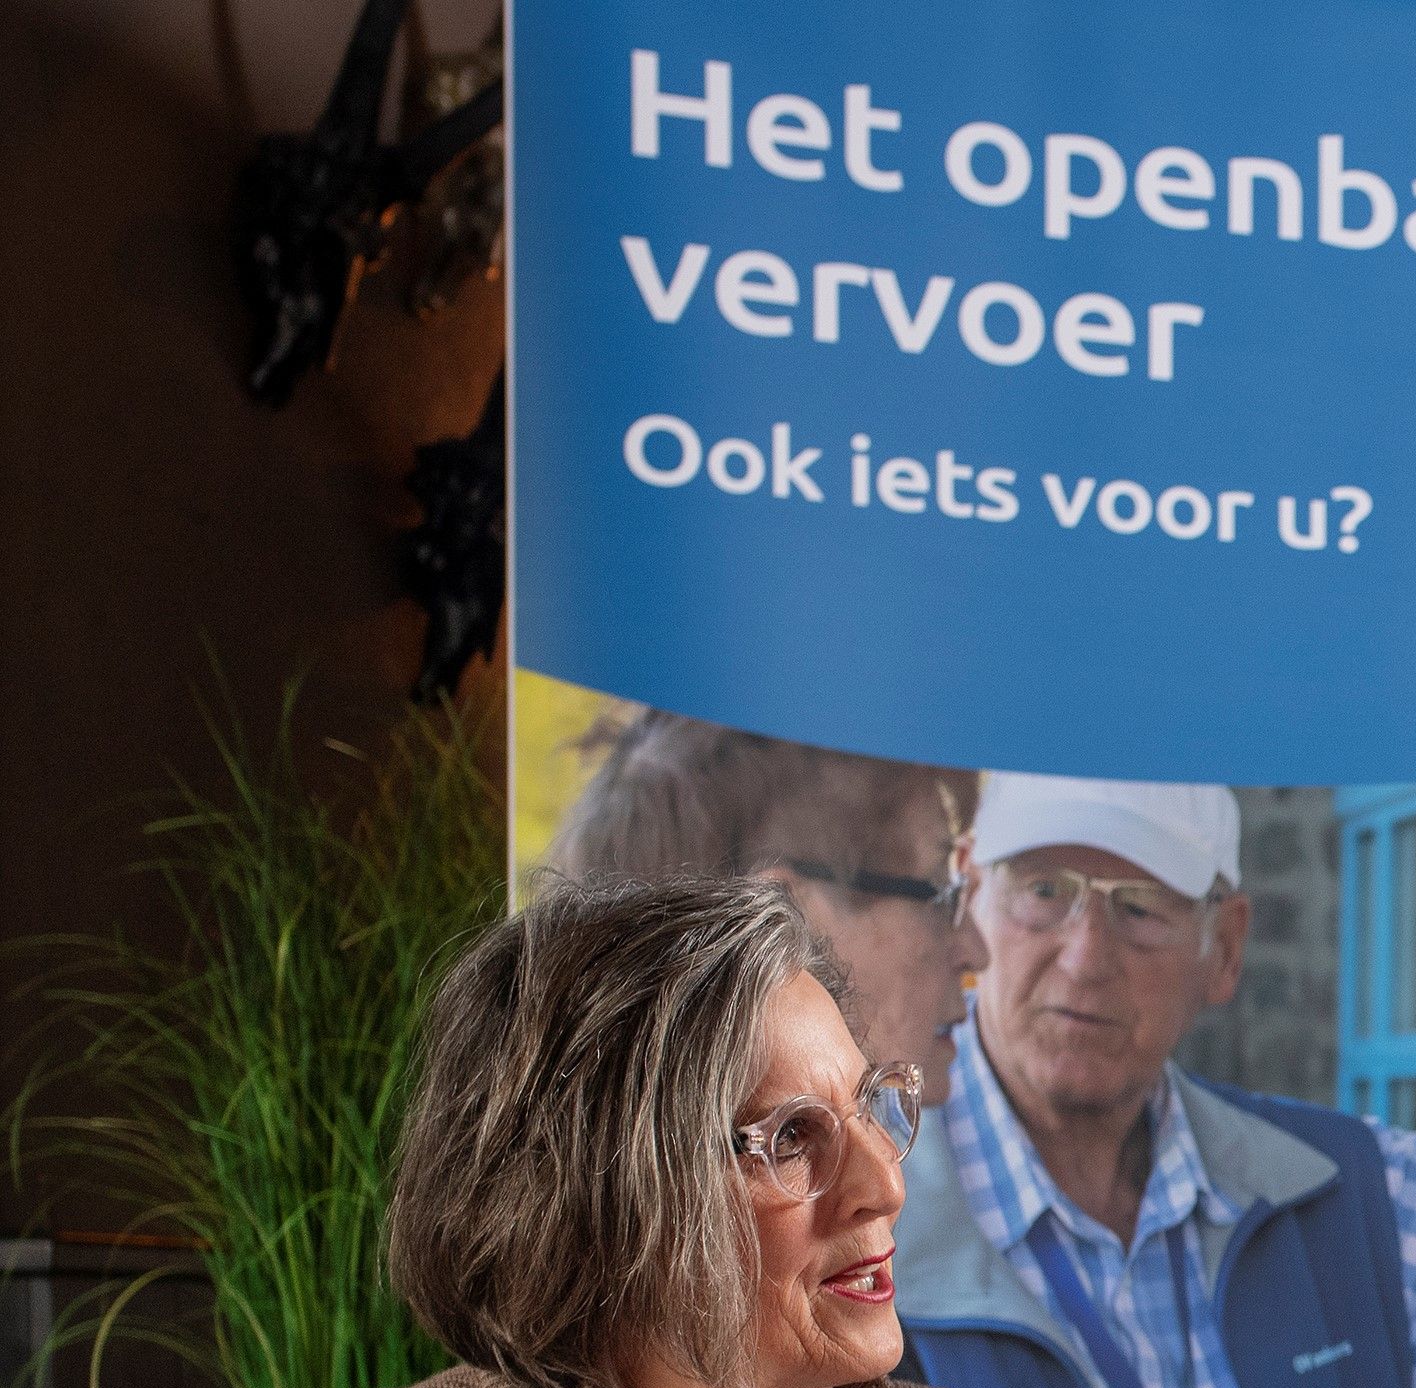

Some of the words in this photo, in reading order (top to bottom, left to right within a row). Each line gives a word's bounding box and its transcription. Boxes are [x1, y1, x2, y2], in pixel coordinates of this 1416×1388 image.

[629, 48, 904, 194] Het
[620, 235, 1205, 382] vervoer
[622, 413, 824, 505] Ook
[850, 433, 1020, 524] iets
[1042, 473, 1256, 545] voor
[1277, 486, 1374, 553] u?
